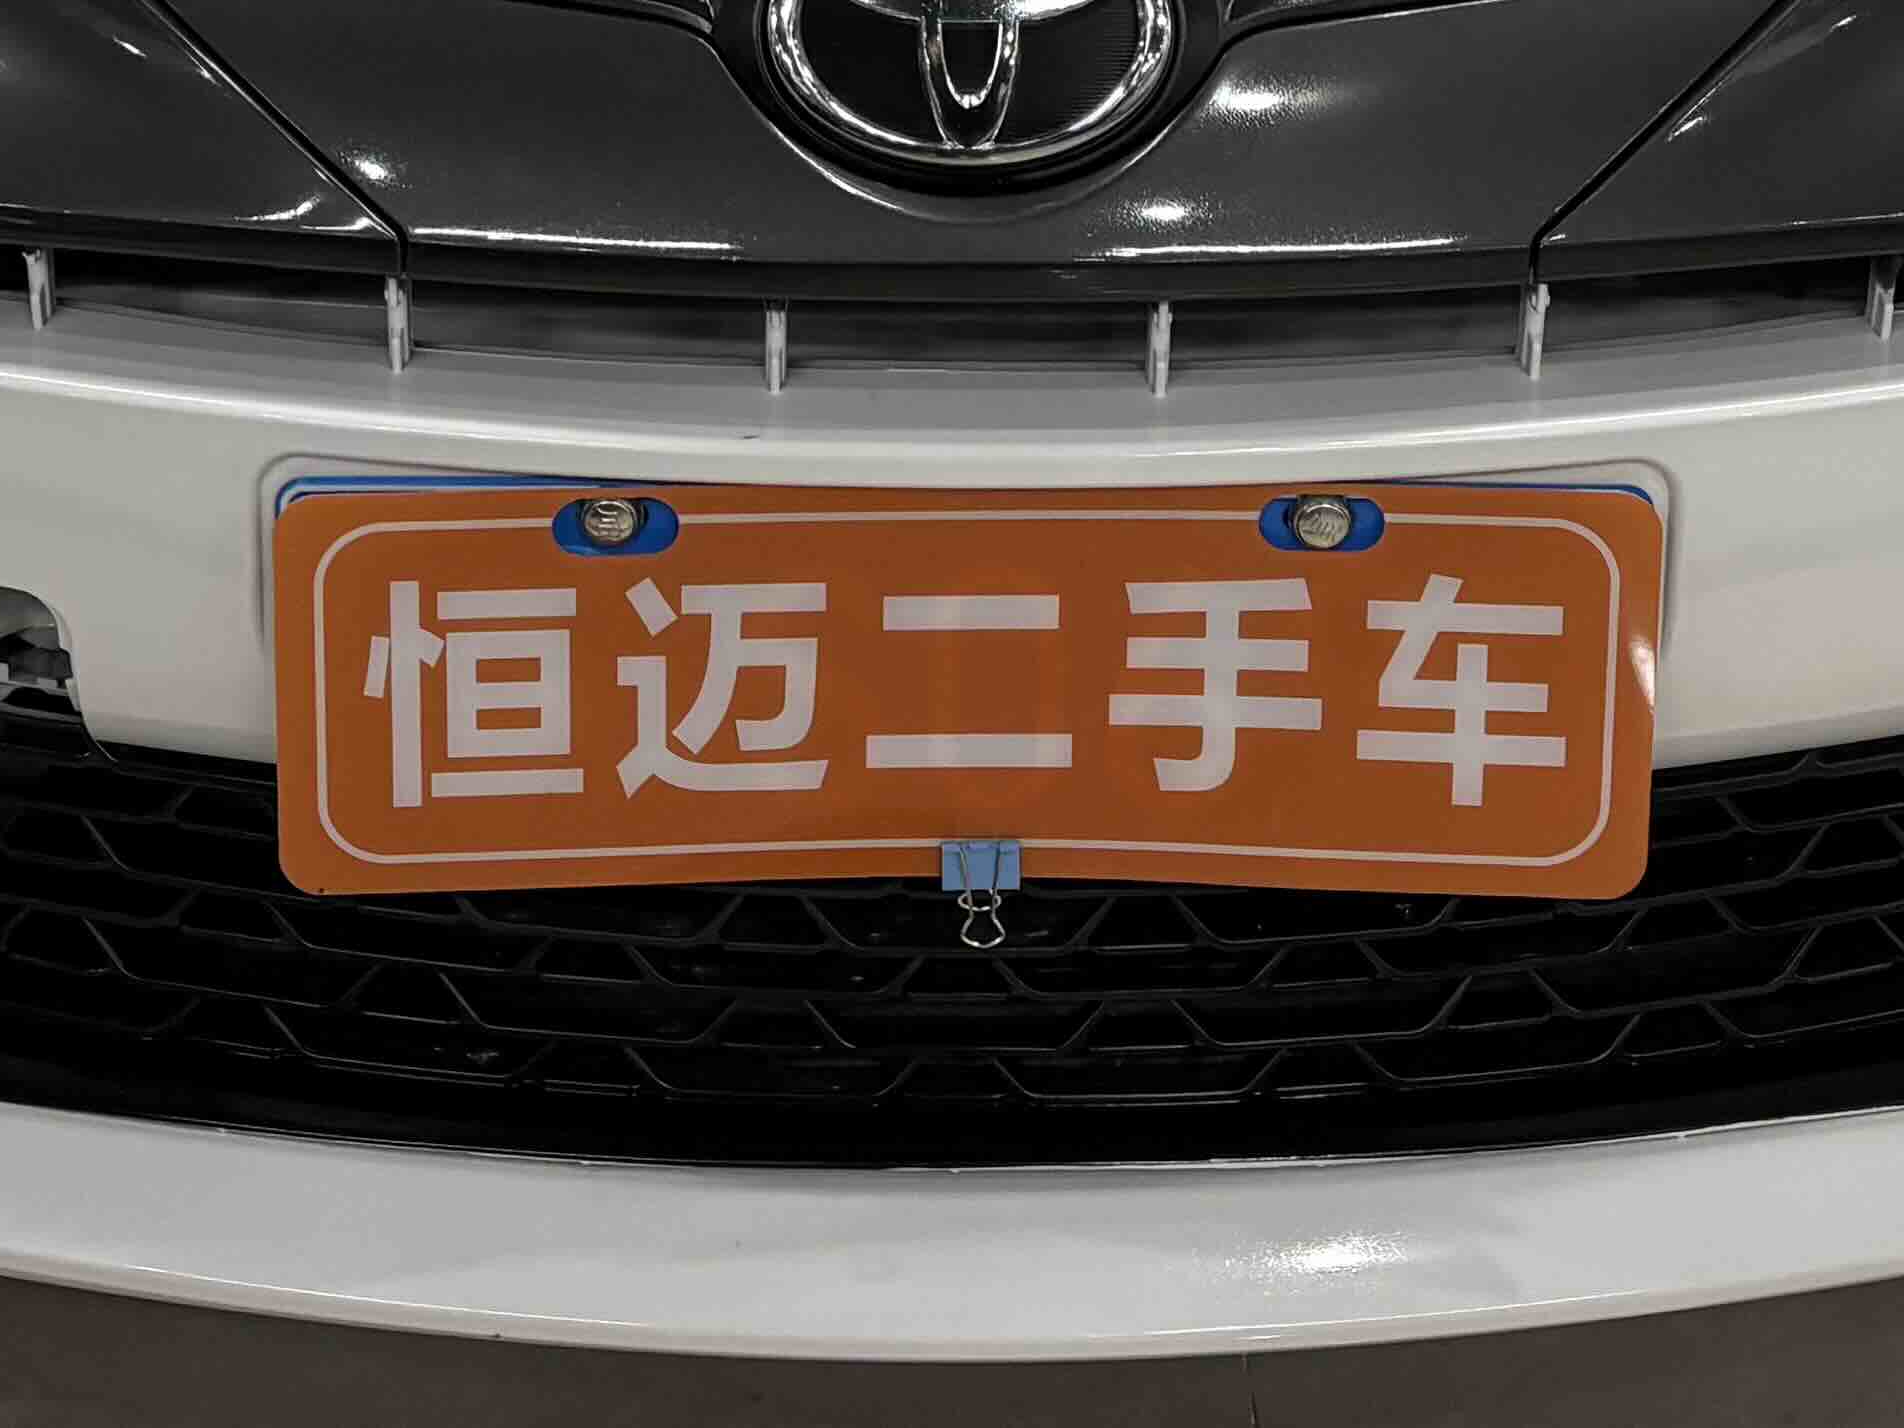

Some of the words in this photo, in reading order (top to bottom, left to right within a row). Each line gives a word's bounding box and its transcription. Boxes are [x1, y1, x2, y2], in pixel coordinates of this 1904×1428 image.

[363, 574, 1567, 807] 恒迈二手车
